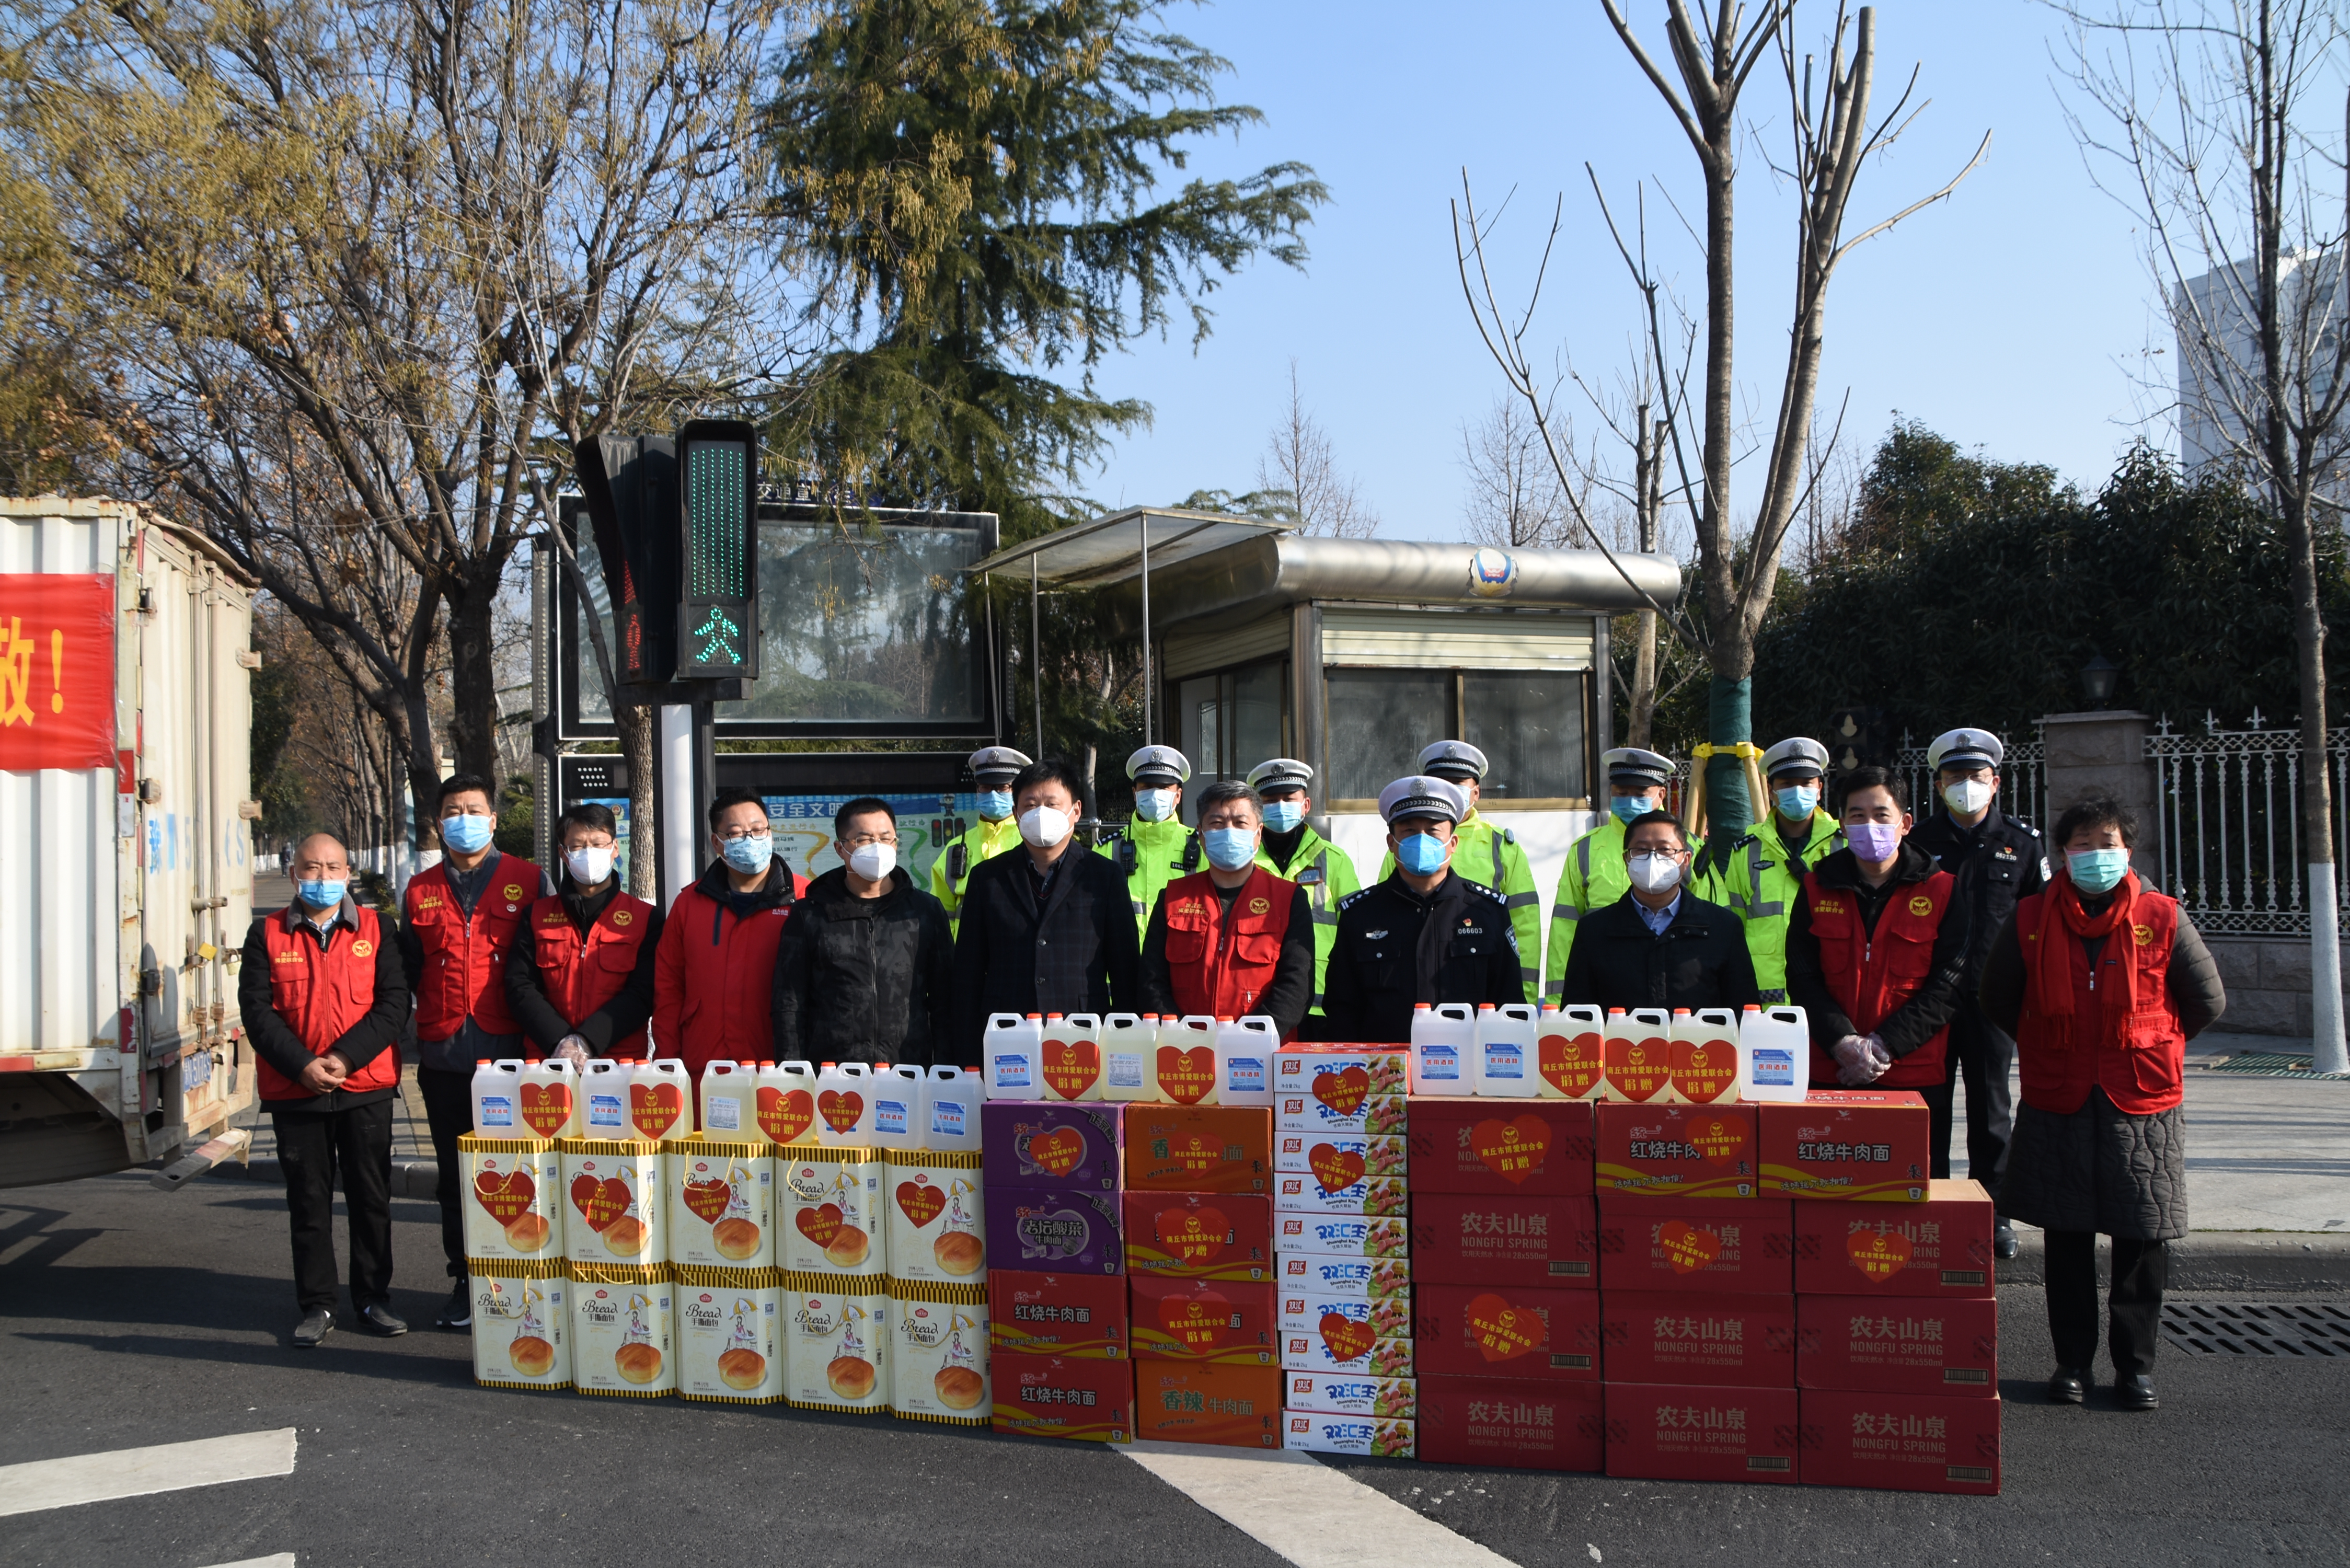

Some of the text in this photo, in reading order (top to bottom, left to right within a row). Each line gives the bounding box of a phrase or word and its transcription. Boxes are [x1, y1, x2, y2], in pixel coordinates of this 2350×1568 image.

[1995, 852, 2018, 861] 062130
[1043, 1065, 1097, 1076] 商丘市博爱联合会
[1283, 1062, 1299, 1070] 双汇
[1543, 1059, 1604, 1072] 商丘市博爱联合会
[1607, 1065, 1669, 1076] 商丘市博爱联合会
[1058, 1077, 1082, 1089] 捐赠
[1159, 1072, 1214, 1081] 商丘市博爱联合会
[1560, 1073, 1589, 1087] 捐赠
[1174, 1084, 1199, 1097] 捐赠
[1624, 1078, 1653, 1091] 捐赠
[1687, 1080, 1716, 1095] 捐赠
[1321, 1085, 1365, 1099] 商丘市博爱联合会
[1335, 1097, 1357, 1108] 捐赠
[523, 1106, 569, 1115] 商丘市博爱联合会
[757, 1110, 809, 1123] 商丘市博爱联合会
[535, 1117, 557, 1128] 捐赠
[642, 1118, 665, 1129] 捐赠
[832, 1116, 849, 1126] 捐赠
[770, 1122, 794, 1136] 捐赠
[1013, 1122, 1043, 1135] 统一
[1149, 1125, 1176, 1135] 统一
[1630, 1125, 1662, 1139] 统一
[1798, 1126, 1831, 1140] 统一
[1286, 1140, 1299, 1149] 双汇
[1694, 1136, 1742, 1145] 商丘市博爱联合会
[1038, 1146, 1078, 1160] 商丘市博爱联合会
[1481, 1141, 1544, 1157] 商丘市博爱联合会
[1630, 1140, 1702, 1160] 红烧牛肉
[1707, 1146, 1730, 1157] 捐赠
[1798, 1142, 1891, 1163] 红烧牛肉面
[1050, 1157, 1070, 1170] 捐赠
[1186, 1160, 1207, 1170] 捐赠
[1314, 1161, 1357, 1179] 商丘市博爱联合会
[1501, 1156, 1530, 1172] 捐赠
[1322, 1172, 1344, 1186] 捐赠
[690, 1196, 727, 1207] 商丘市博爱联合会
[901, 1200, 940, 1211] 商丘市博爱联合会
[494, 1205, 517, 1216] 捐赠
[589, 1210, 609, 1223] 捐赠
[701, 1205, 719, 1217] 捐赠
[910, 1208, 929, 1220] 捐赠
[1015, 1206, 1045, 1218] 统一
[803, 1220, 839, 1233] 商丘市博爱联合会
[1023, 1219, 1084, 1237] 老坛酸菜
[1286, 1222, 1300, 1231] 双汇
[1461, 1212, 1548, 1236] 农夫山泉
[815, 1230, 832, 1241] 捐赠
[1166, 1233, 1222, 1243] 商丘市博爱联合会
[1315, 1223, 1367, 1240] 双汇王
[1035, 1236, 1062, 1246] 牛肉面
[1461, 1236, 1548, 1249] NONGFU SPRING
[1183, 1244, 1207, 1258] 捐赠
[1664, 1238, 1710, 1260] 商丘市博爱联合会
[1672, 1251, 1695, 1267] 捐赠
[1853, 1251, 1904, 1262] 商丘市博爱联合会
[1290, 1262, 1305, 1272] 双汇
[1319, 1263, 1372, 1281] 双汇王
[1867, 1262, 1890, 1273] 捐赠
[478, 1293, 512, 1308] Bread
[1014, 1291, 1041, 1303] 统一
[582, 1299, 618, 1315] Bread
[685, 1304, 722, 1319] Bread
[1015, 1304, 1090, 1323] 红烧牛肉面
[588, 1312, 615, 1322] 手撕面包
[691, 1317, 719, 1327] 手撕面包
[794, 1310, 832, 1325] Bread
[1169, 1318, 1226, 1329] 商丘市博爱联合会
[901, 1318, 938, 1335] Bread
[1473, 1318, 1531, 1347] 商丘市博爱联合会
[1654, 1316, 1743, 1342] 农夫山泉
[1849, 1315, 1944, 1342] 农夫山泉
[1186, 1330, 1213, 1343] 捐赠
[1324, 1329, 1367, 1349] 商丘市博爱联合会
[1333, 1341, 1354, 1356] 捐赠
[1482, 1333, 1512, 1354] 捐赠
[1654, 1341, 1743, 1355] NONGFU SPRING
[1850, 1340, 1943, 1356] NONGFU SPRING
[1019, 1372, 1046, 1385] 统一
[1160, 1375, 1188, 1388] 统一
[1296, 1380, 1310, 1390] 双汇
[1021, 1386, 1096, 1406] 红烧牛肉面
[1325, 1382, 1377, 1400] 双汇王
[1161, 1390, 1253, 1416] 香辣 牛肉面
[1467, 1401, 1554, 1426] 农夫山泉
[1656, 1405, 1746, 1431] 农夫山泉
[1293, 1420, 1307, 1429] 双汇
[1852, 1411, 1947, 1438] 农夫山泉
[1322, 1423, 1374, 1440] 双汇王
[1468, 1425, 1554, 1440] NONGFU SPRING
[1656, 1429, 1746, 1444] NONGFU SPRING
[1852, 1437, 1946, 1453] NONGFU SPRING
